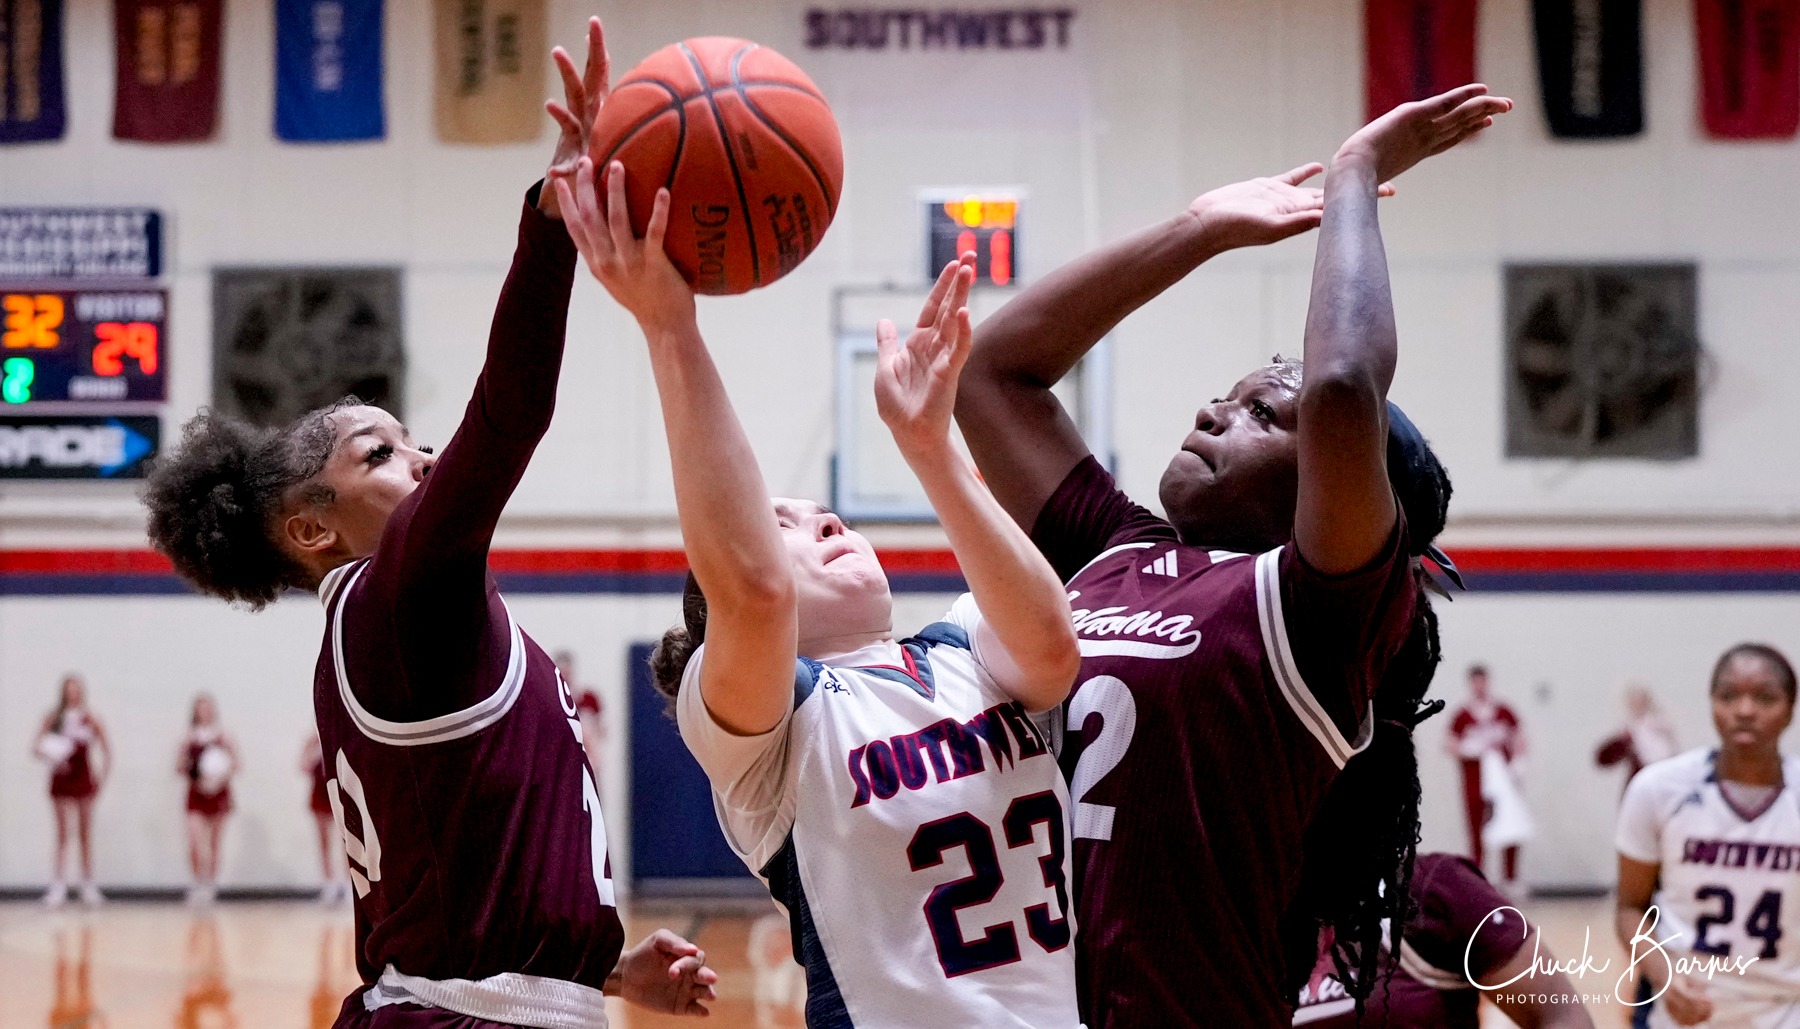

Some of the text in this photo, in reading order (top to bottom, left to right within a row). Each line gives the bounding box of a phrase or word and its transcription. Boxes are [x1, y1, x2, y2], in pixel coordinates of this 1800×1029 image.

[804, 8, 1074, 50] SOUTHWEST
[2, 294, 64, 349] 32
[92, 321, 158, 376] 29
[848, 702, 1048, 809] SOUTHWE
[906, 789, 1071, 979] 23
[1692, 885, 1782, 960] 24
